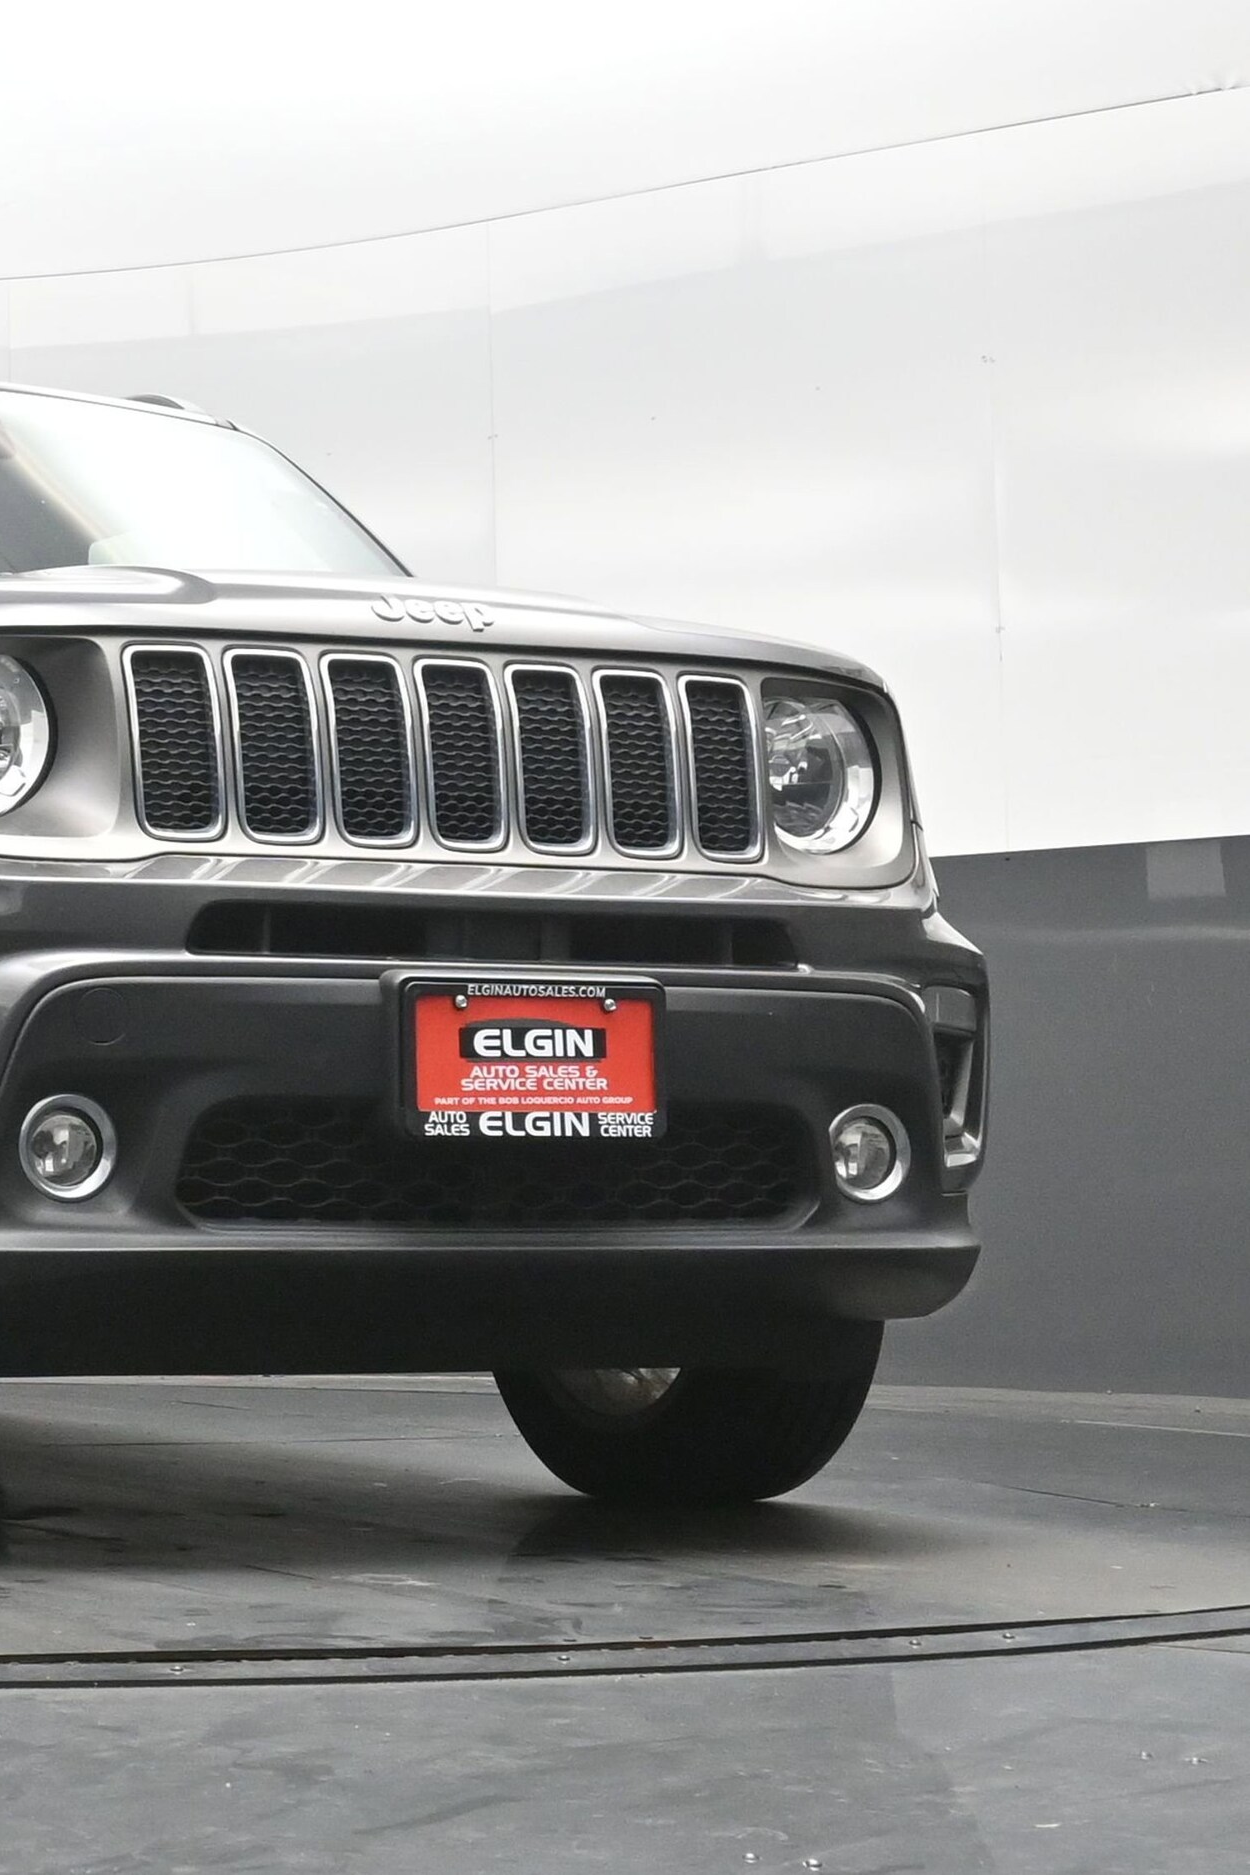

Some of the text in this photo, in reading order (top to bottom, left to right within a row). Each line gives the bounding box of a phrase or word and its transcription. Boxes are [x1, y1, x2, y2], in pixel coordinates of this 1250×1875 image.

[371, 593, 494, 632] Jeep
[466, 984, 606, 998] ELGINAUTOSALES.COM
[473, 1028, 594, 1057] ELGIN
[470, 1065, 598, 1078] AUTO SALES &
[461, 1078, 608, 1091] SERVICE CENTER
[434, 1097, 460, 1105] PART
[461, 1097, 475, 1105] OF
[576, 1096, 600, 1104] AUTO
[602, 1096, 633, 1104] GROUP
[428, 1111, 467, 1123] AUTO
[479, 1111, 590, 1136] ELGIN
[597, 1112, 654, 1124] SERVICE
[424, 1124, 470, 1136] SALES
[600, 1125, 652, 1137] CENTER
